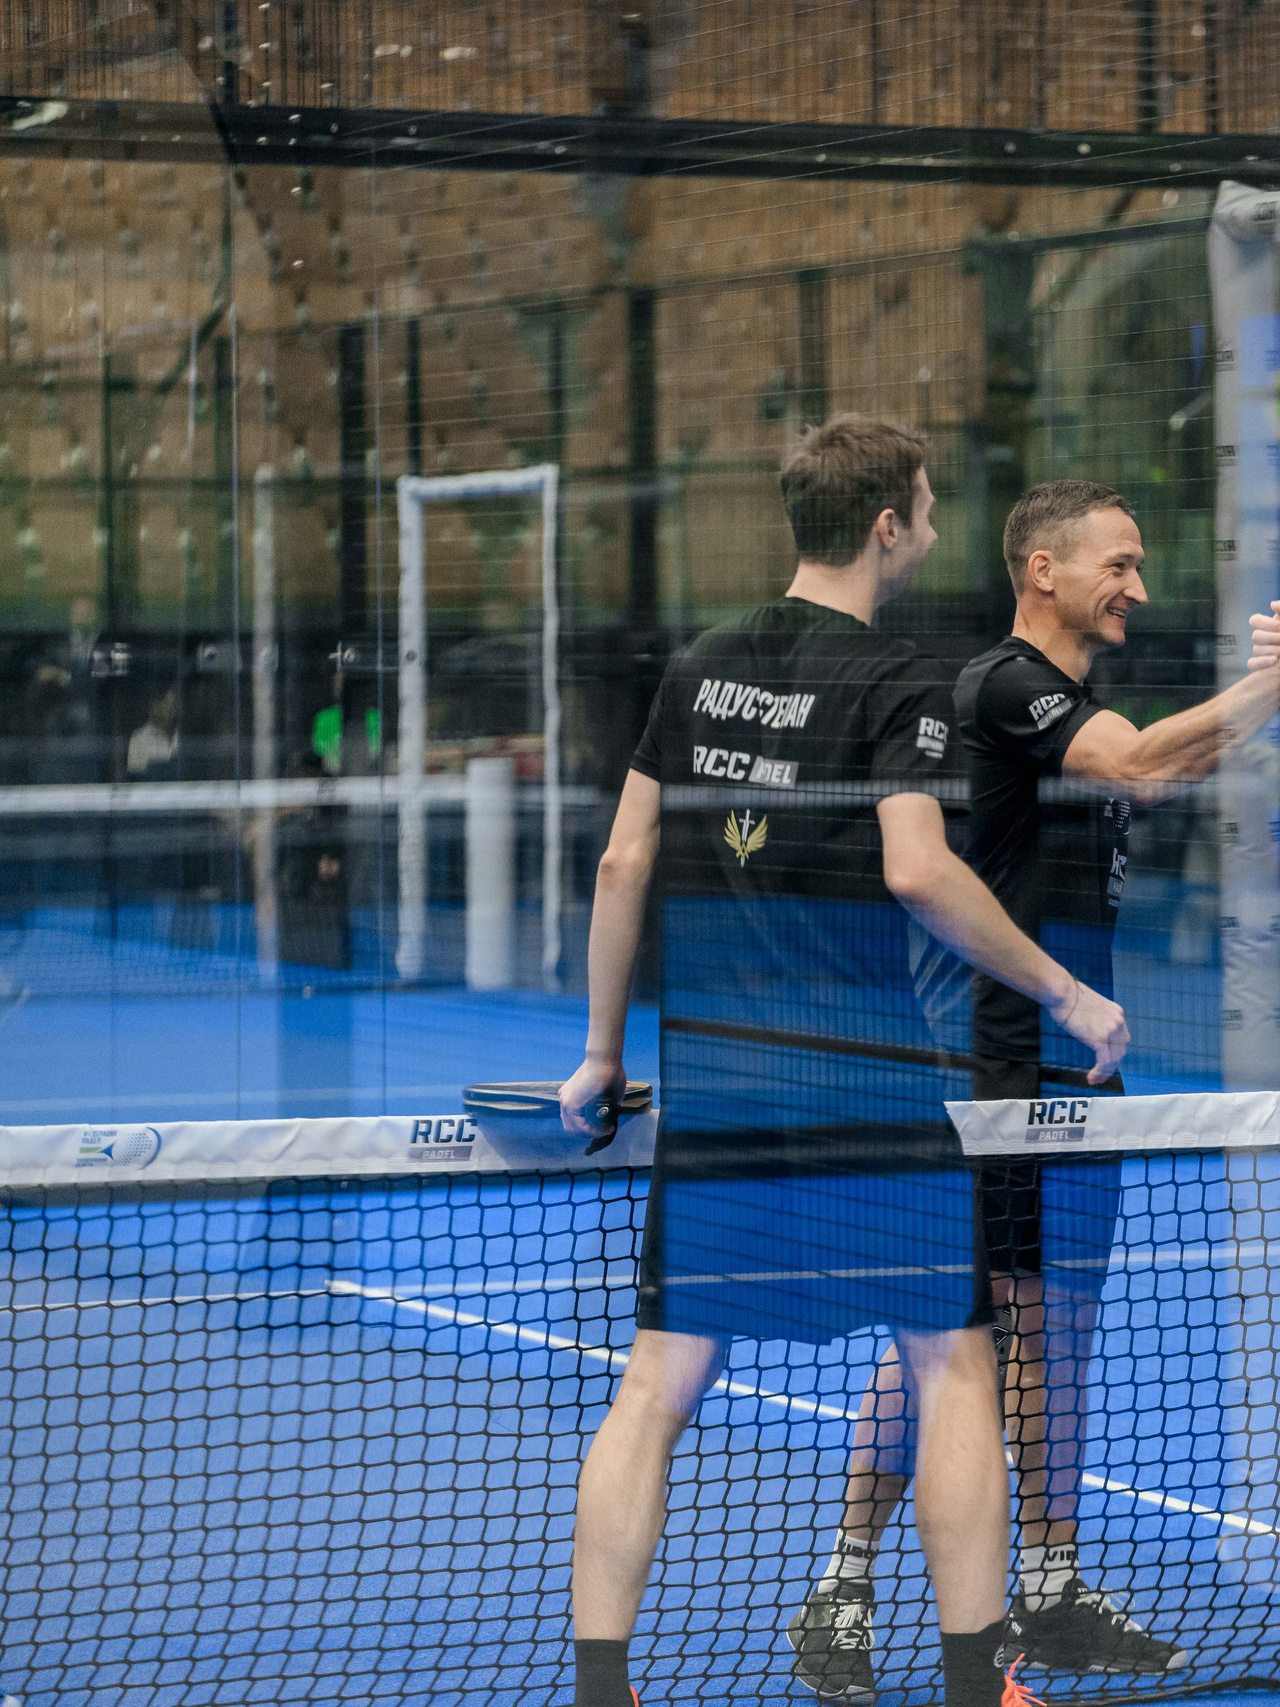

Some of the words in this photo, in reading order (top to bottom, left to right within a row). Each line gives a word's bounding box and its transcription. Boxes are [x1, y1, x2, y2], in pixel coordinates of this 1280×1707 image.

[693, 745, 751, 780] RCC
[1027, 1100, 1089, 1125] RCC
[409, 1119, 478, 1143] RCC
[1038, 1130, 1070, 1141] PADEL
[421, 1149, 456, 1160] PADEL
